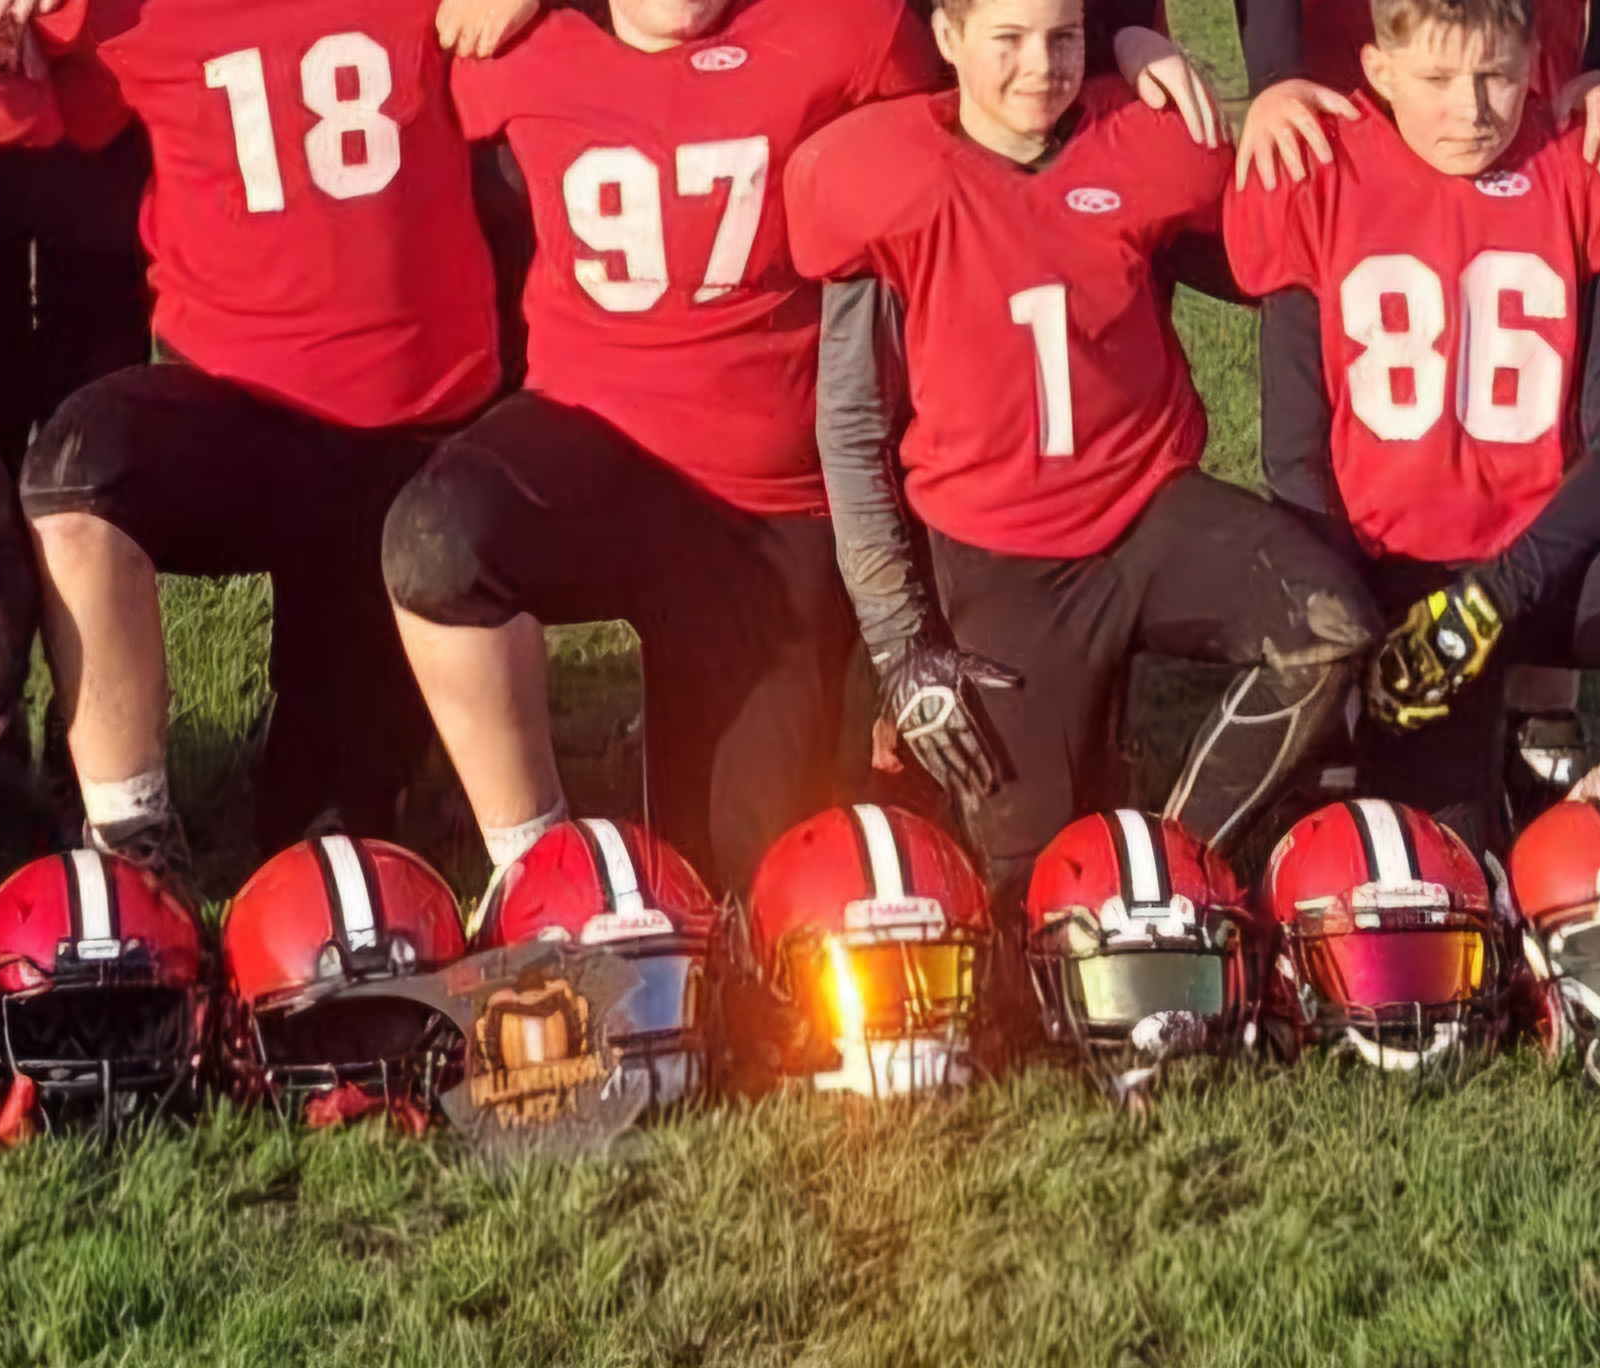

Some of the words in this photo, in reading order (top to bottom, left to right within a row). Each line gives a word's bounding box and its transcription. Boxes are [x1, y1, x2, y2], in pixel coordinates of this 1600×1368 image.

[204, 31, 401, 213] 18
[562, 135, 770, 313] 97
[1008, 283, 1074, 457] 1
[1340, 250, 1567, 444] 86
